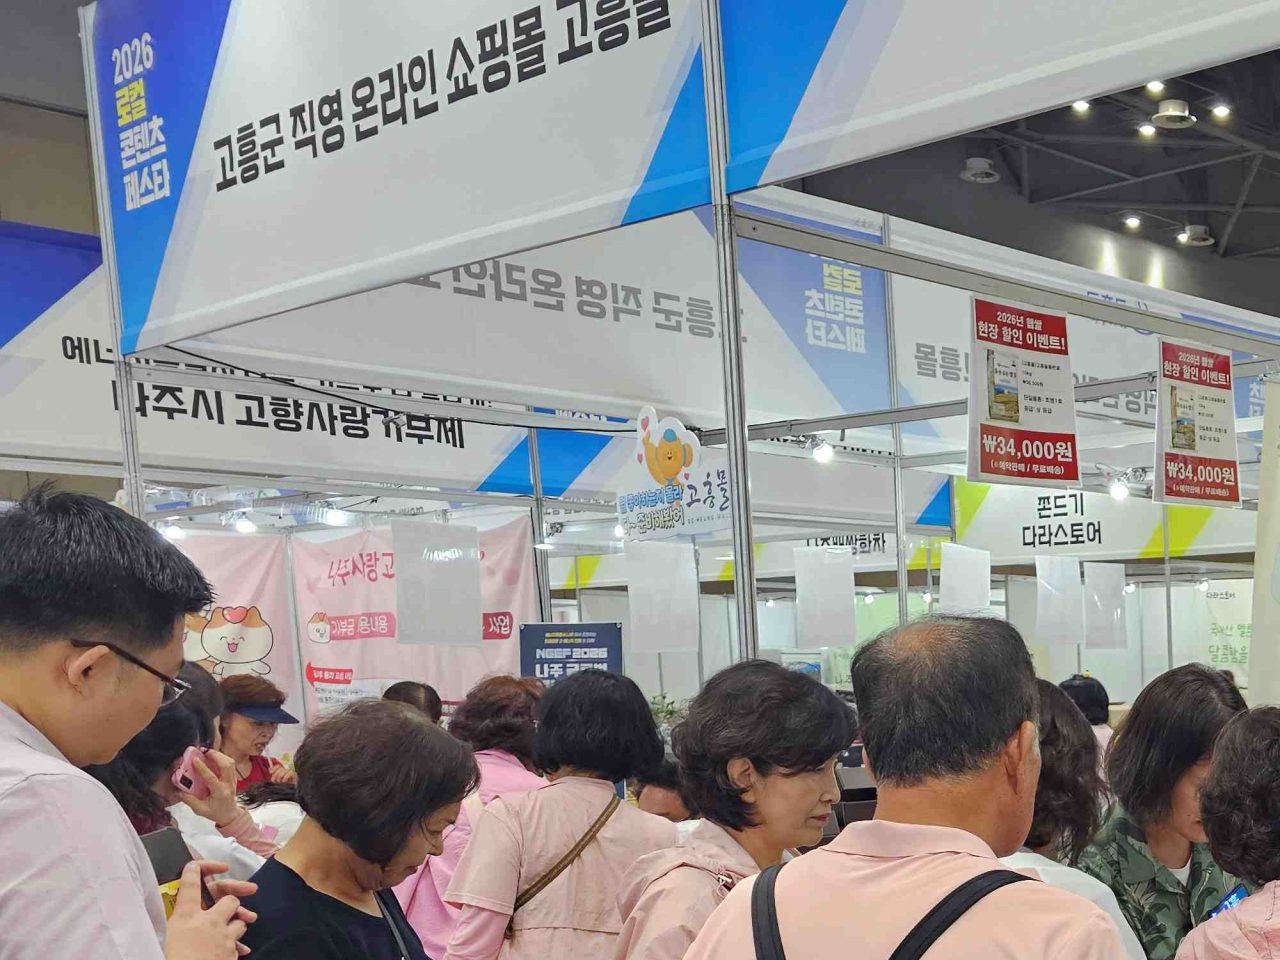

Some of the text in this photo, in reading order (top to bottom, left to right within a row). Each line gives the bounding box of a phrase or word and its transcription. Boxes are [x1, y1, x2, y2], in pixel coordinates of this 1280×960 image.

[111, 32, 154, 84] 2026
[115, 77, 147, 127] 로컬
[213, 112, 285, 192] 고흥군
[289, 89, 345, 158] 직영
[352, 48, 438, 142] 온라인
[446, 5, 547, 104] 쇼핑몰
[119, 115, 167, 169] 콘텐츠
[123, 158, 170, 211] 페스타
[997, 312, 1024, 327] 2026년
[978, 321, 1065, 350] 현장 할인 이벤트!
[1163, 361, 1230, 385] 현장 할인 이벤트!
[1178, 352, 1200, 366] 2026년
[982, 434, 1073, 462] ₩34,000원
[1166, 460, 1235, 485] ₩34,000원
[1037, 493, 1084, 518] 쫀드기
[1022, 520, 1102, 548] 다라스토어
[572, 648, 608, 658] 2026
[535, 663, 563, 678] 나주
